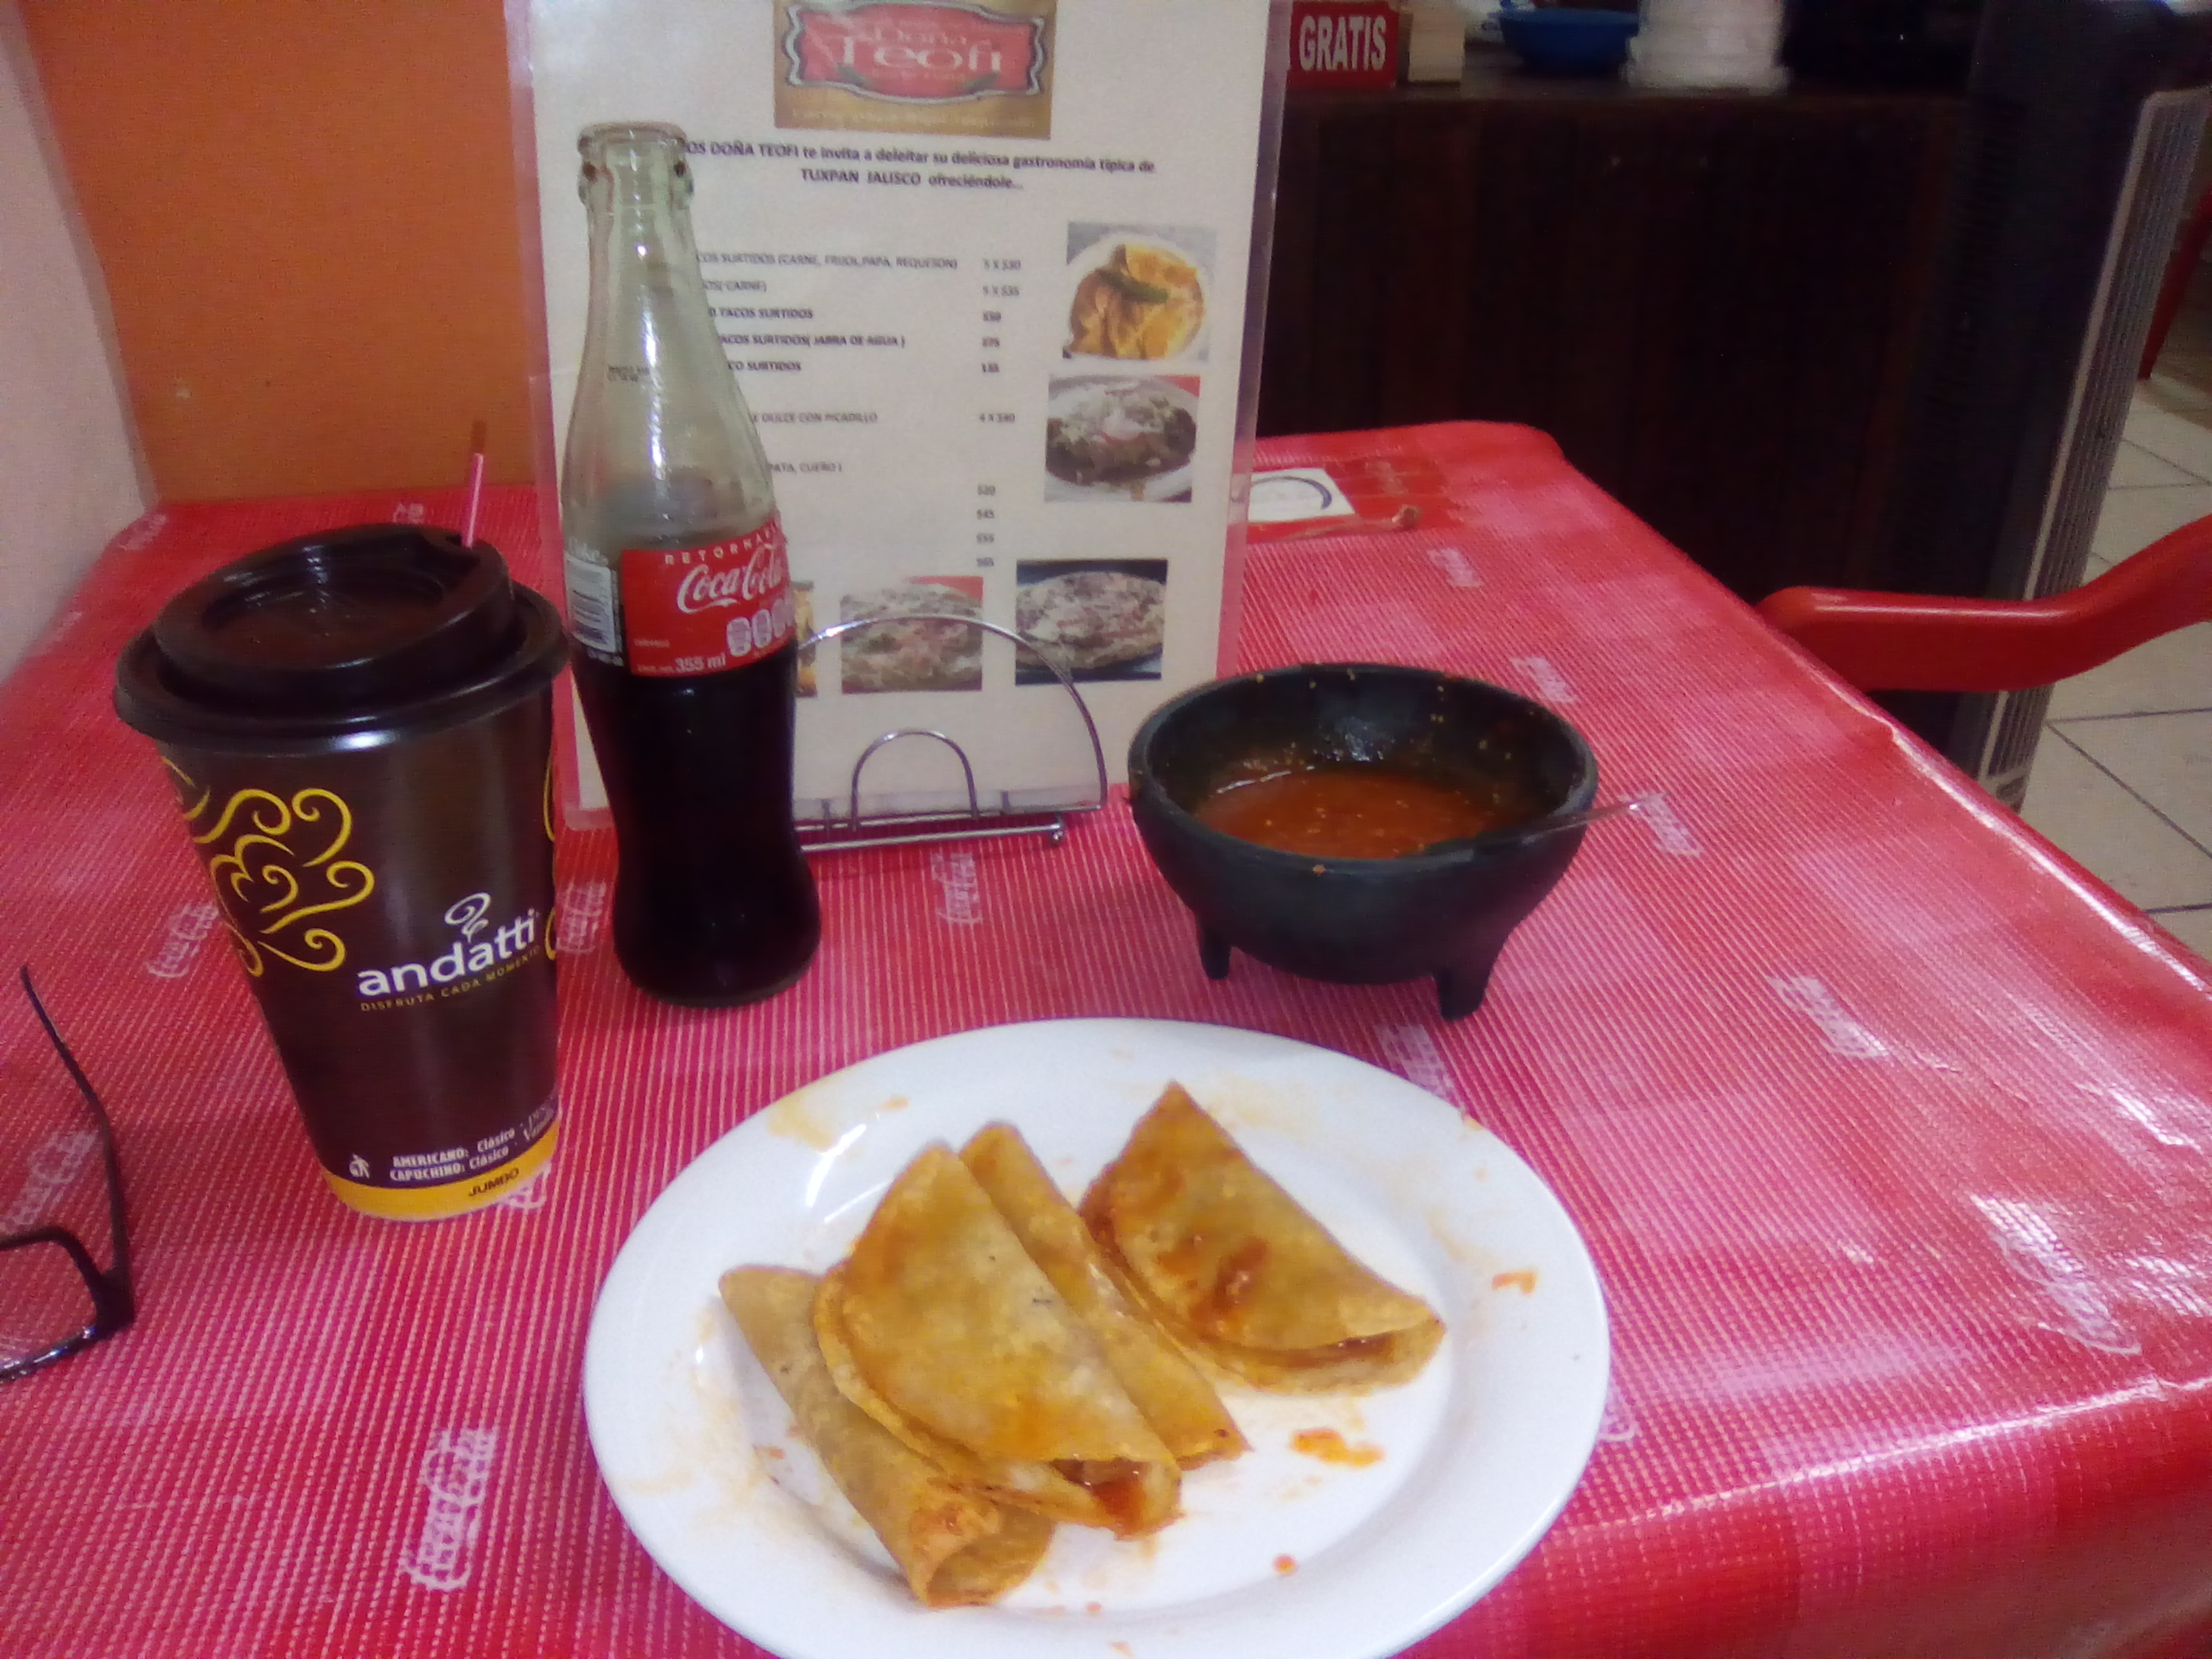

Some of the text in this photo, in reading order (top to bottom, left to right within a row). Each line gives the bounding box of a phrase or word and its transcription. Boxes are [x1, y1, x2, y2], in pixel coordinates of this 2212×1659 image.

[1299, 15, 1387, 71] GRATIS
[711, 140, 754, 155] DOÑA
[759, 143, 798, 157] TEOFI
[803, 146, 817, 159] te
[864, 150, 872, 161] a
[876, 146, 928, 163] deleitar
[933, 152, 948, 163] su
[951, 150, 1010, 166] deliciosa
[1139, 159, 1155, 173] de
[801, 168, 860, 184] TUXPAN
[867, 171, 921, 186] JALISCO
[720, 253, 775, 264] SURTIDOS
[719, 308, 756, 319] TACOS
[758, 308, 814, 319] SURTIDOS
[849, 335, 863, 346] DE
[746, 361, 802, 372] SURTIDOS
[761, 412, 796, 423] DULCE
[798, 412, 822, 423] CON
[825, 412, 878, 424] PICADILLO
[676, 656, 704, 674] 355
[708, 651, 726, 668] ml
[357, 908, 535, 996] andatti
[360, 993, 436, 1012] DISFRUTA
[441, 978, 482, 998] CADA
[393, 1147, 470, 1168] AMERICANO:
[468, 1166, 520, 1197] JUMBO
